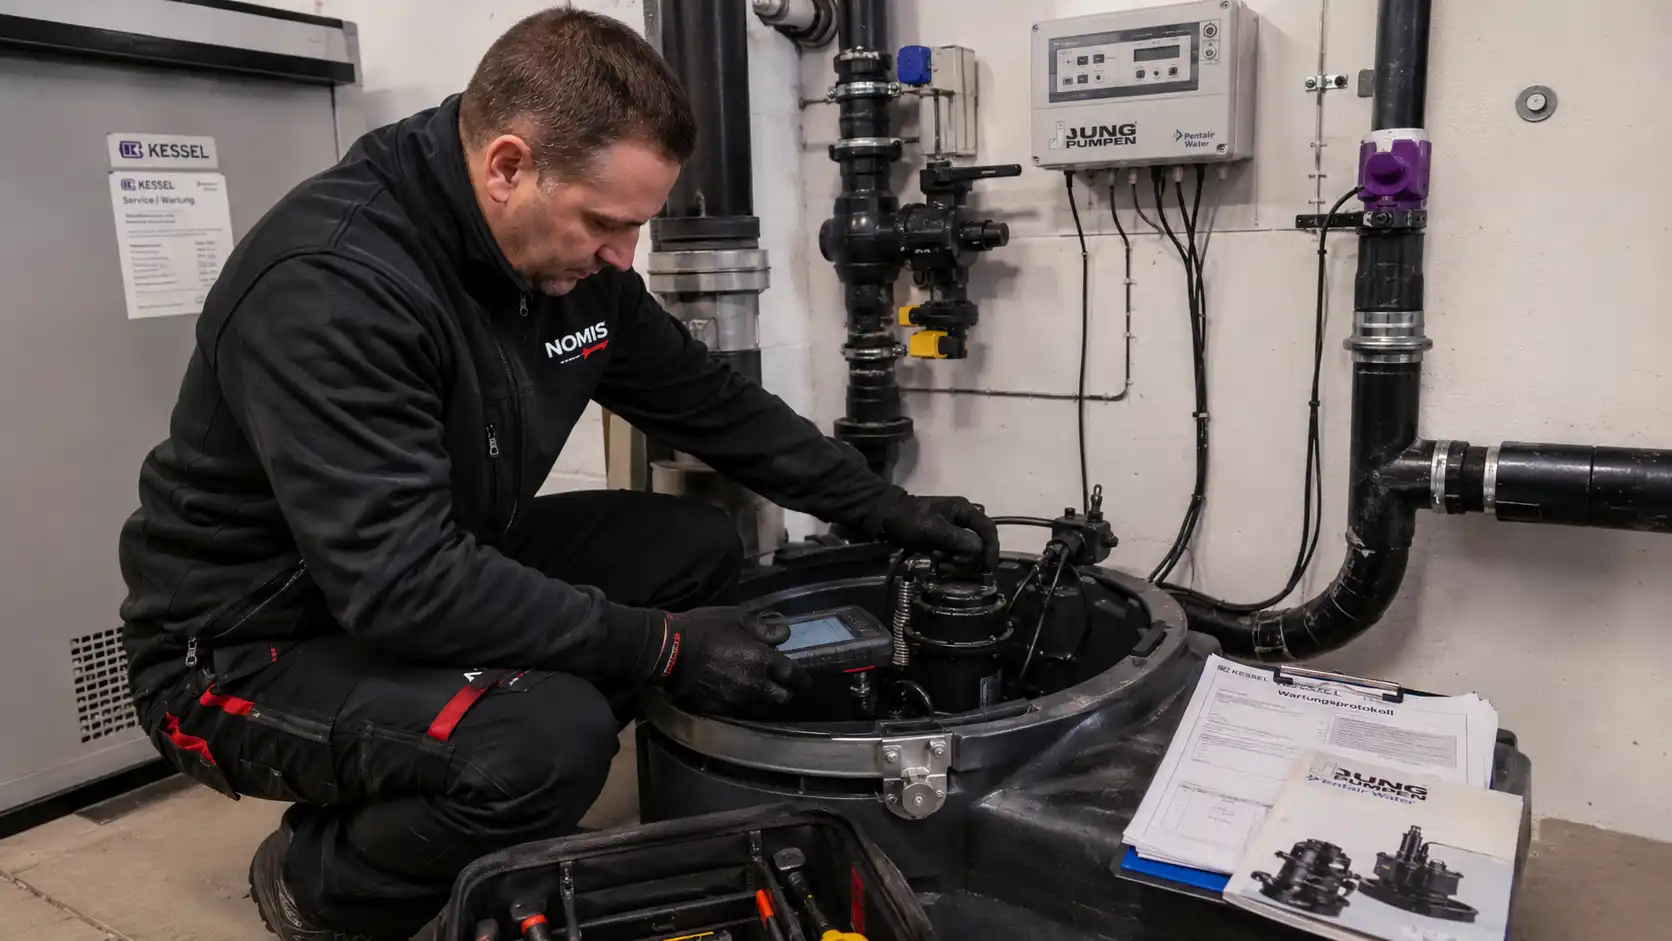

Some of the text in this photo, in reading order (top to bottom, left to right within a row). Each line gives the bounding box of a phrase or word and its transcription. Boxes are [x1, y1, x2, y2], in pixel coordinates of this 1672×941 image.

[1066, 136, 1136, 149] PUMPEN
[148, 143, 210, 159] KESSEL
[138, 180, 175, 190] KESSEL
[122, 196, 154, 205] Service
[161, 196, 195, 206] Wartung
[545, 321, 608, 358] NOMIS
[1277, 689, 1395, 716] Wartungsprotokoll
